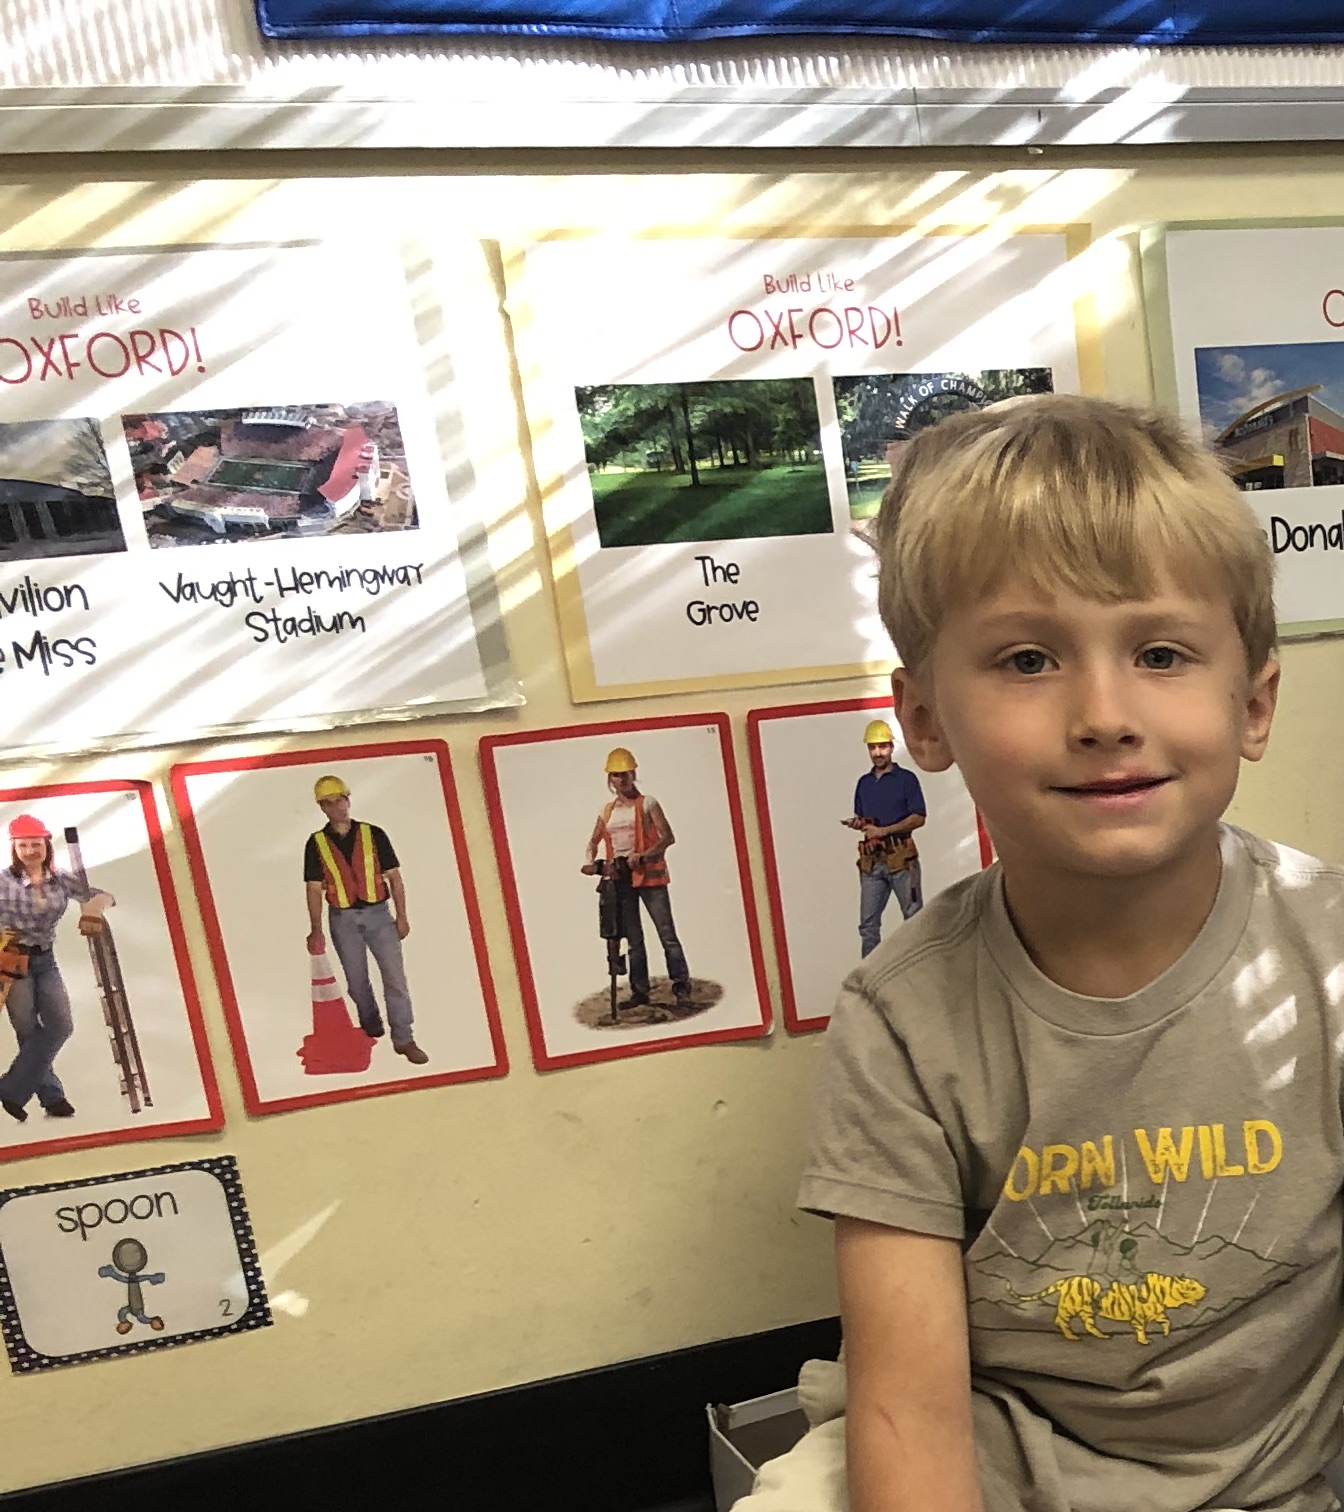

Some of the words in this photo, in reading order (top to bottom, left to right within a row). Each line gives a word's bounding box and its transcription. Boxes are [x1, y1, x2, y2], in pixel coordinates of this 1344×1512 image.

[763, 272, 812, 295] Build
[817, 271, 856, 293] Like
[27, 295, 89, 320] Build
[95, 293, 142, 317] Like
[728, 305, 904, 352] OXFORD!
[0, 326, 206, 384] OXFORD!
[894, 394, 919, 430] WALK
[918, 381, 935, 398] OF
[694, 555, 741, 587] The
[244, 605, 367, 643] Stadium
[686, 600, 760, 626] Grove
[11, 629, 98, 676] Miss
[1134, 1118, 1284, 1185] WILD
[55, 1190, 179, 1241] spoon
[219, 1298, 234, 1317] 2
